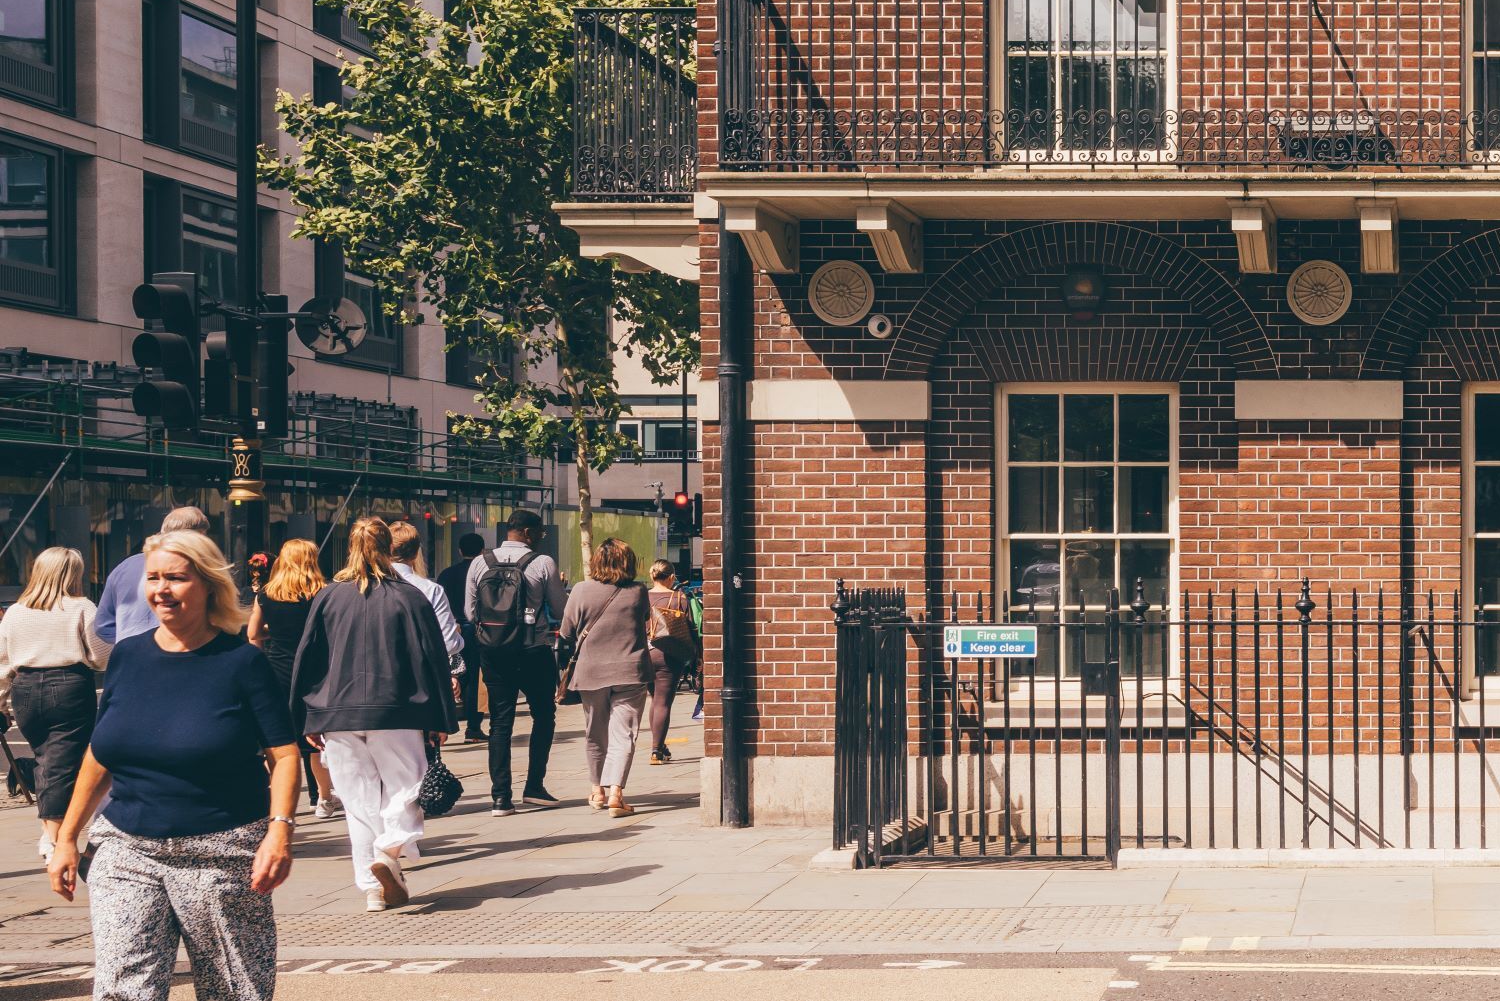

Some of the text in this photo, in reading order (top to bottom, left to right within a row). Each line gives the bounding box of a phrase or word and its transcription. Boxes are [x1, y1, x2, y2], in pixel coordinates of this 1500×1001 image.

[976, 631, 1019, 640] Fire exit
[970, 643, 1026, 653] Keep clear
[275, 957, 824, 975] LOOK BOT
